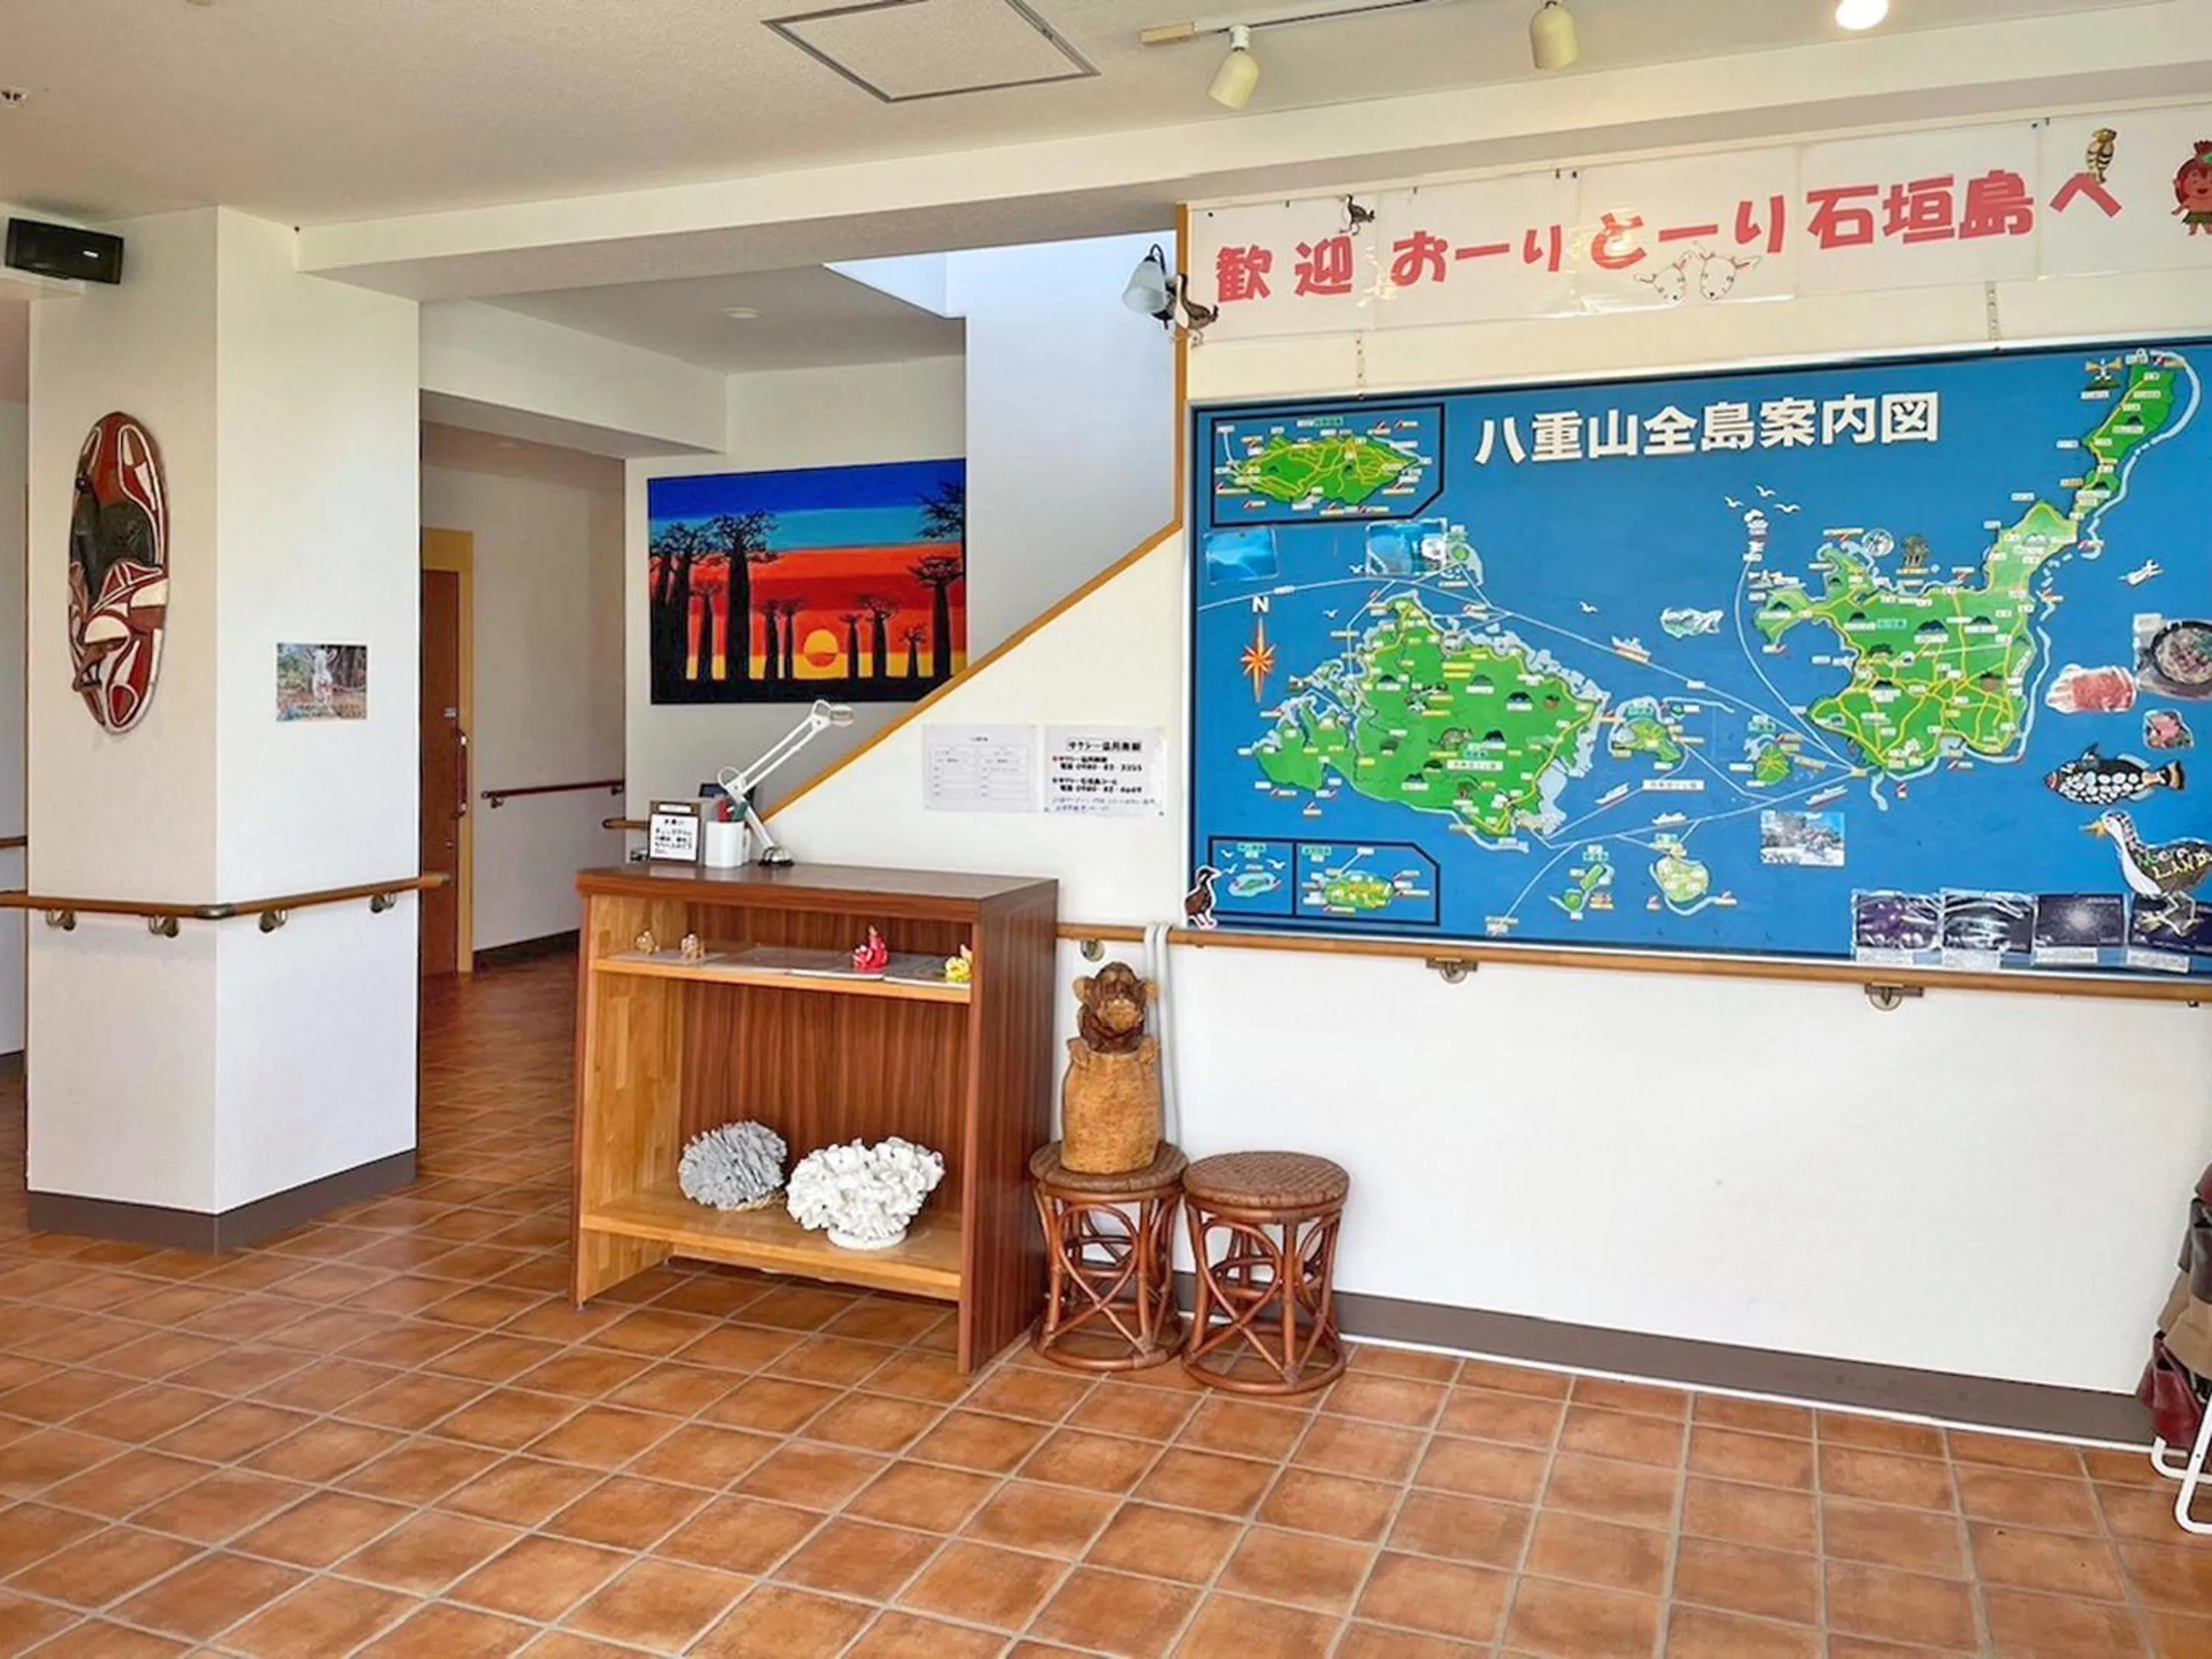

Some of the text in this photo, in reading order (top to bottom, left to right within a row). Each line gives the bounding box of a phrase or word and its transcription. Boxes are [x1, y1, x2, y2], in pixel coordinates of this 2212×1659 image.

[1215, 236, 1353, 303] 歓迎
[1474, 391, 1939, 464] 八重山全島案内図
[1252, 597, 1270, 614] N
